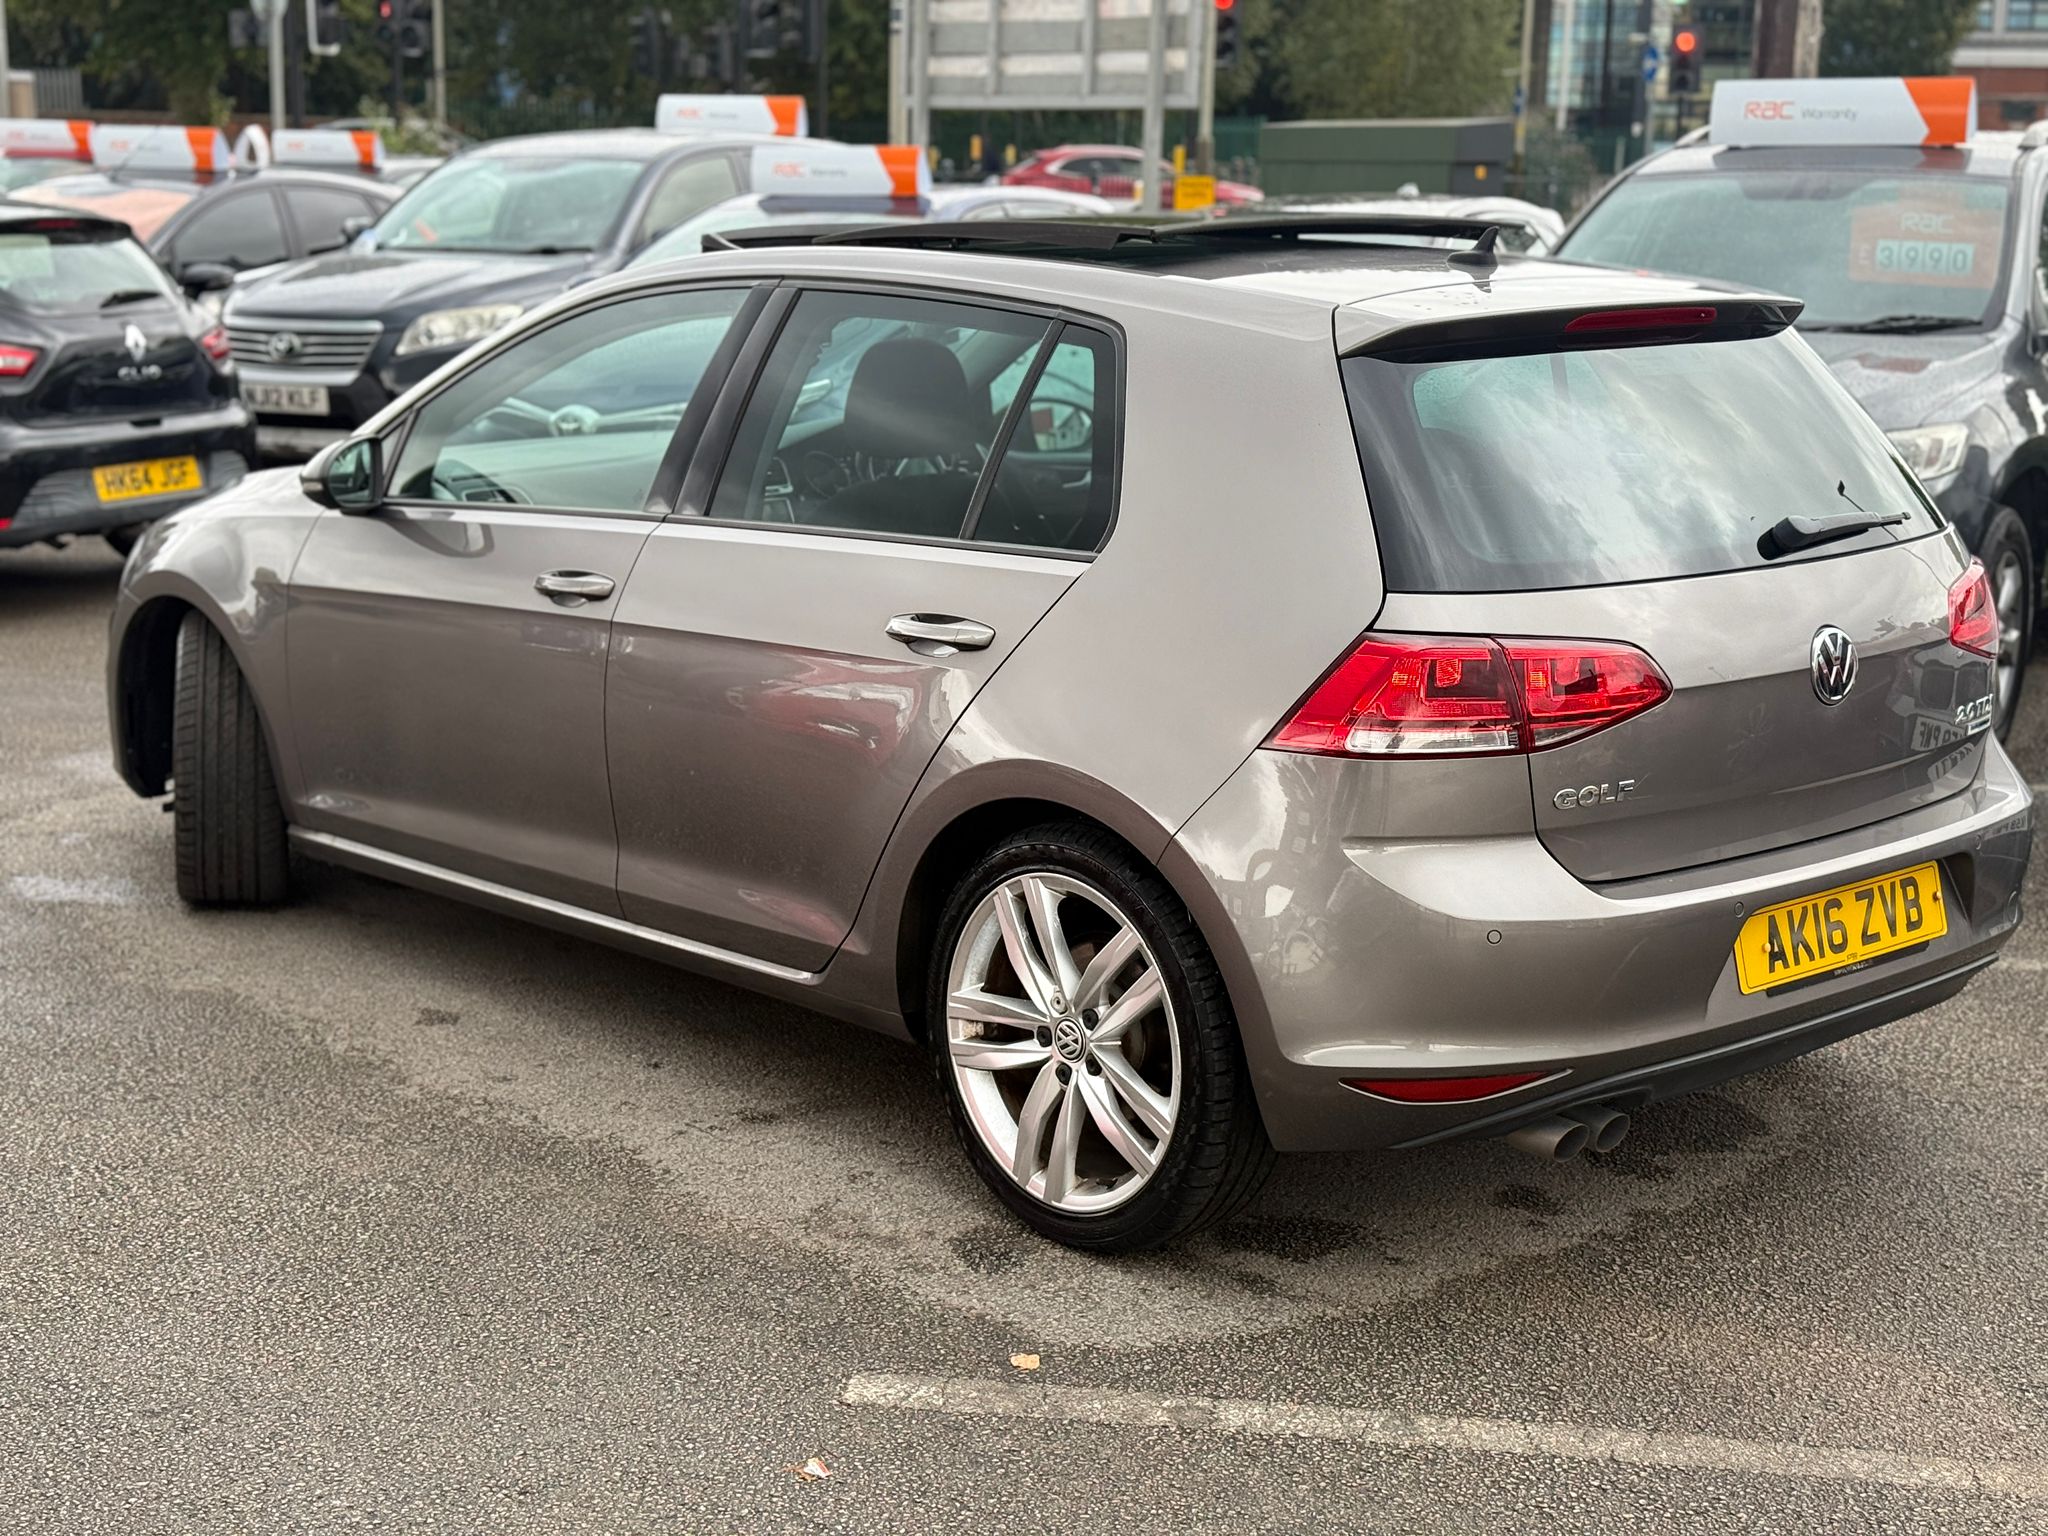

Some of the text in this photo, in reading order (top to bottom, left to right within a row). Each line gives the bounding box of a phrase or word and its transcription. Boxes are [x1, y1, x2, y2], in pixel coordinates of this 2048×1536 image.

[1879, 246, 1968, 272] 3990
[1552, 779, 1635, 810] GOLF
[1768, 876, 1924, 974] AK16 ZVB
